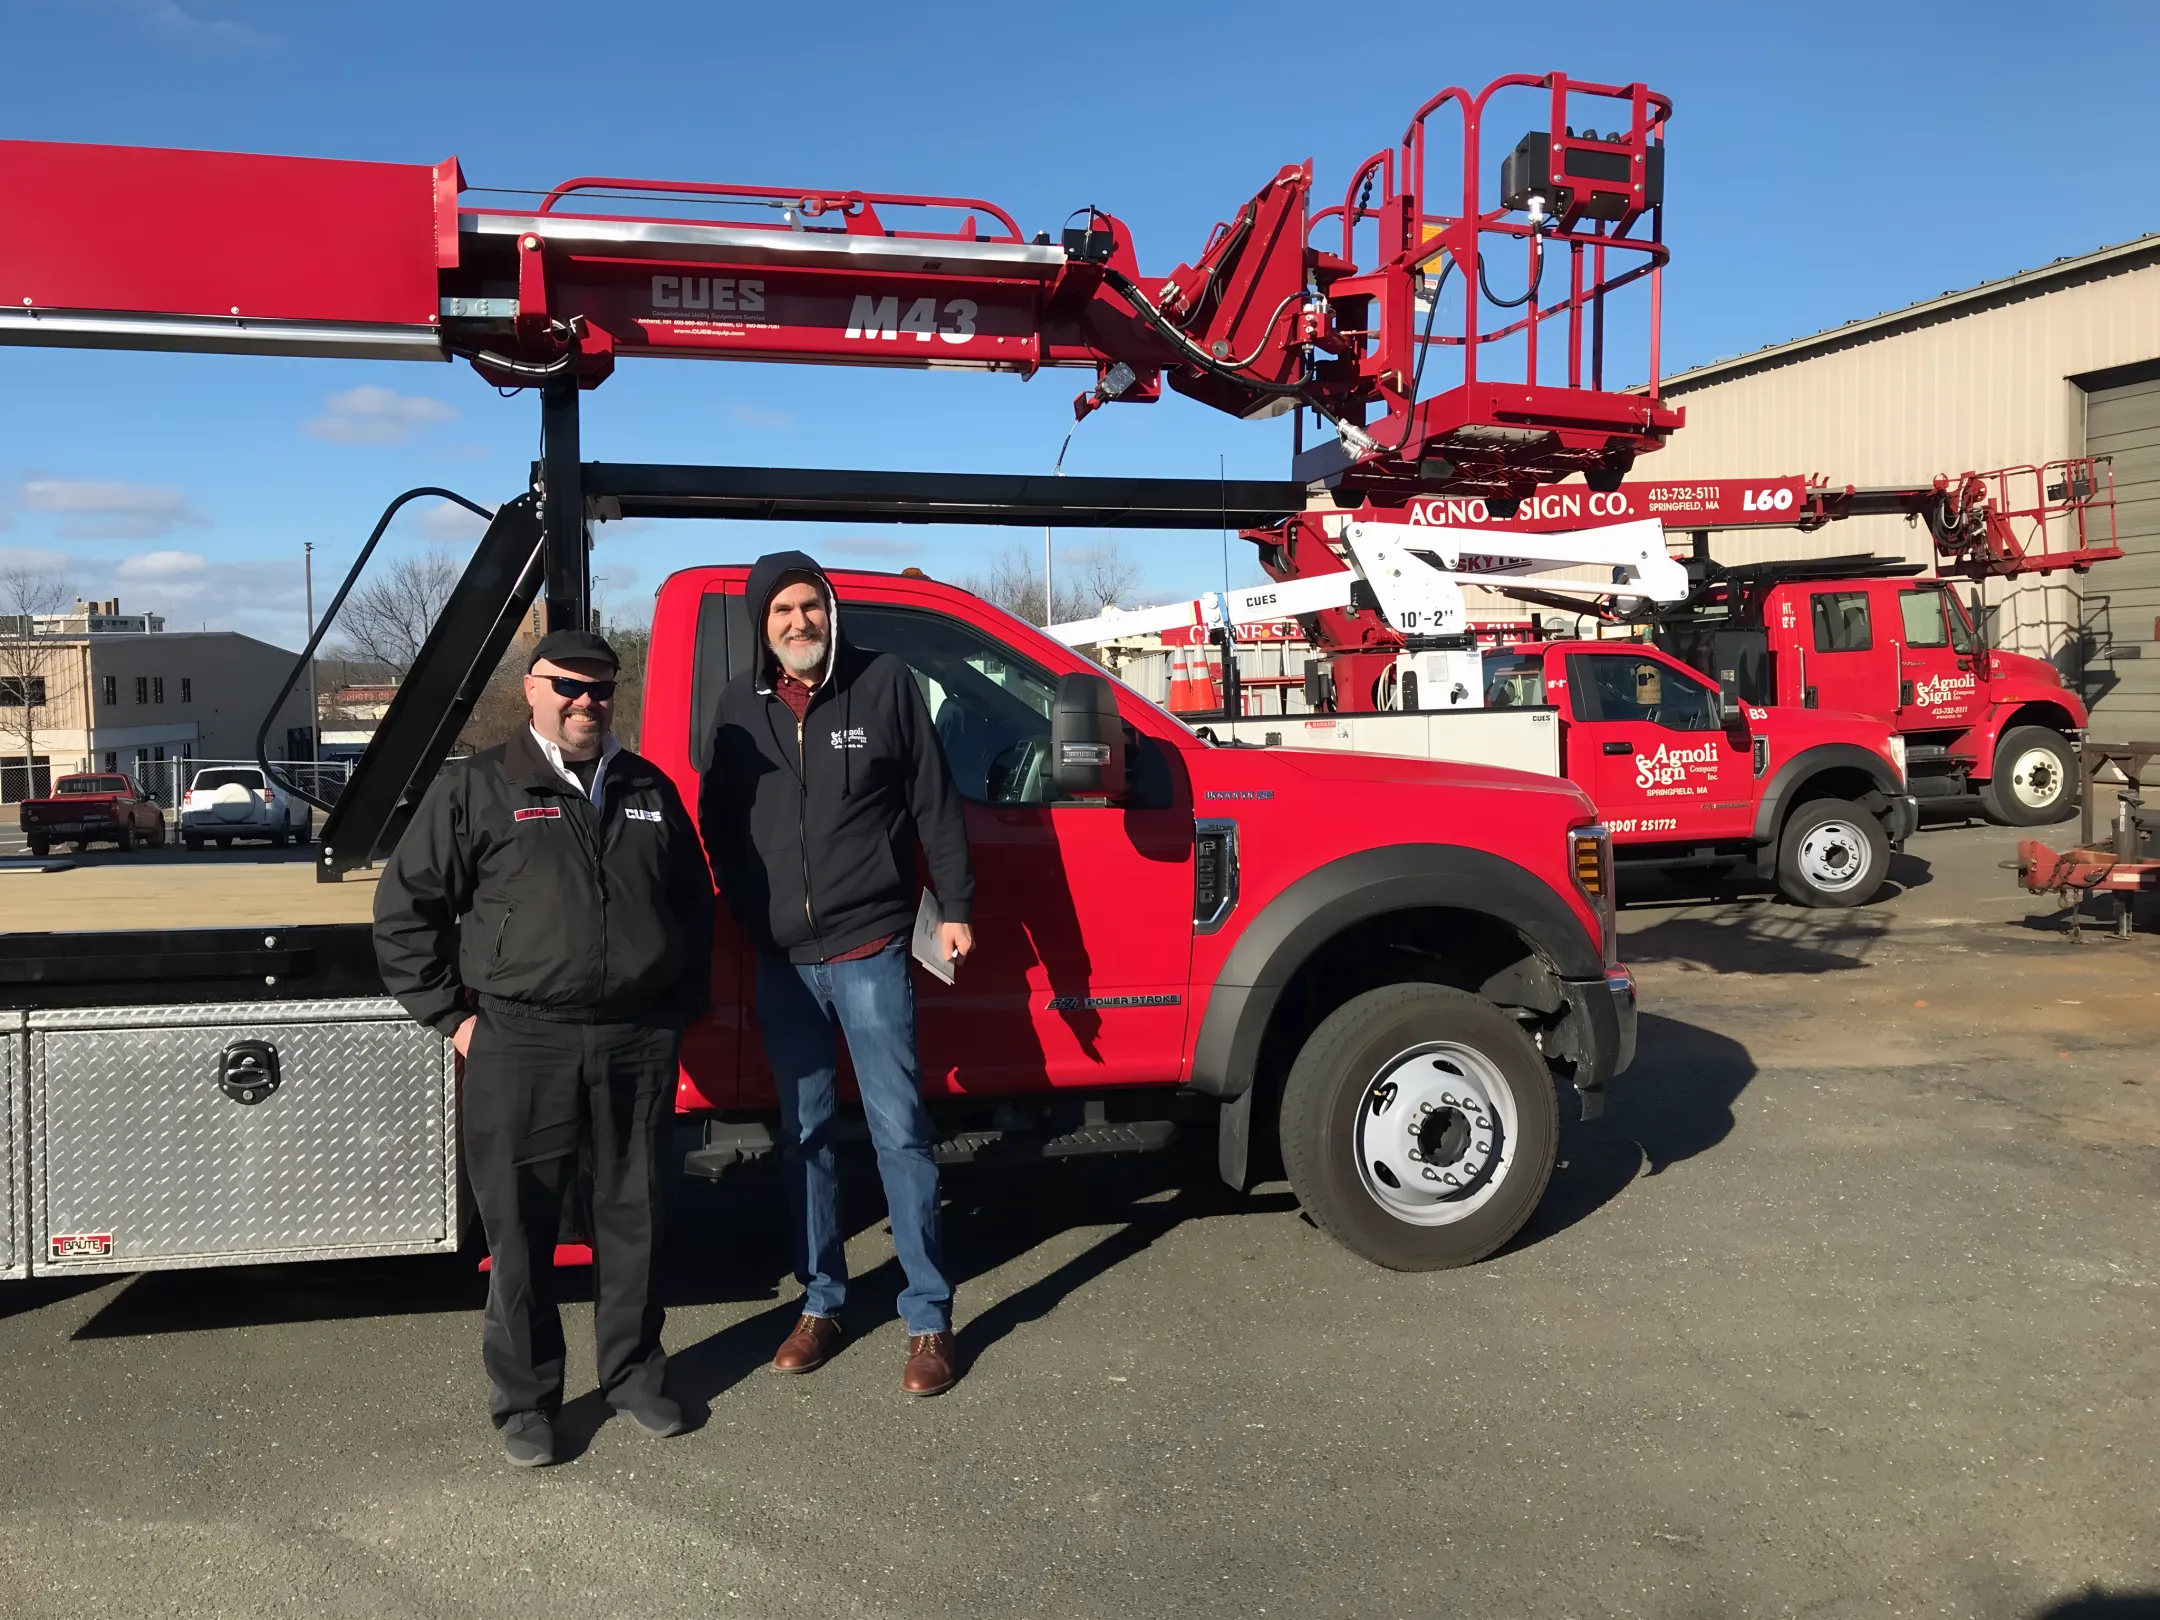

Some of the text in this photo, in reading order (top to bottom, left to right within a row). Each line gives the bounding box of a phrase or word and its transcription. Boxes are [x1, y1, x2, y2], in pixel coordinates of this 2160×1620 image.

[652, 276, 764, 311] CUES
[845, 295, 978, 344] M43
[1648, 487, 1720, 501] 413-732-5111
[1743, 488, 1793, 511] L60
[1409, 492, 1635, 526] AGNO SIGN CO.
[1648, 501, 1719, 512] SPRINGFIELD, MA
[1246, 594, 1277, 607] CUES
[1927, 673, 1975, 691] Agnoli
[1917, 682, 1951, 707] Sign
[1748, 708, 1768, 720] B3
[1650, 743, 1719, 767] Agnoli
[1636, 754, 1686, 788] Sign
[1689, 765, 1718, 774] Company
[1646, 786, 1708, 797] SPRINGFIELD, MA
[625, 808, 662, 822] CUES
[1640, 818, 1677, 831] 251772
[1086, 997, 1129, 1007] POWER
[1131, 994, 1180, 1005] STROKE
[63, 1240, 99, 1250] BRUTE
